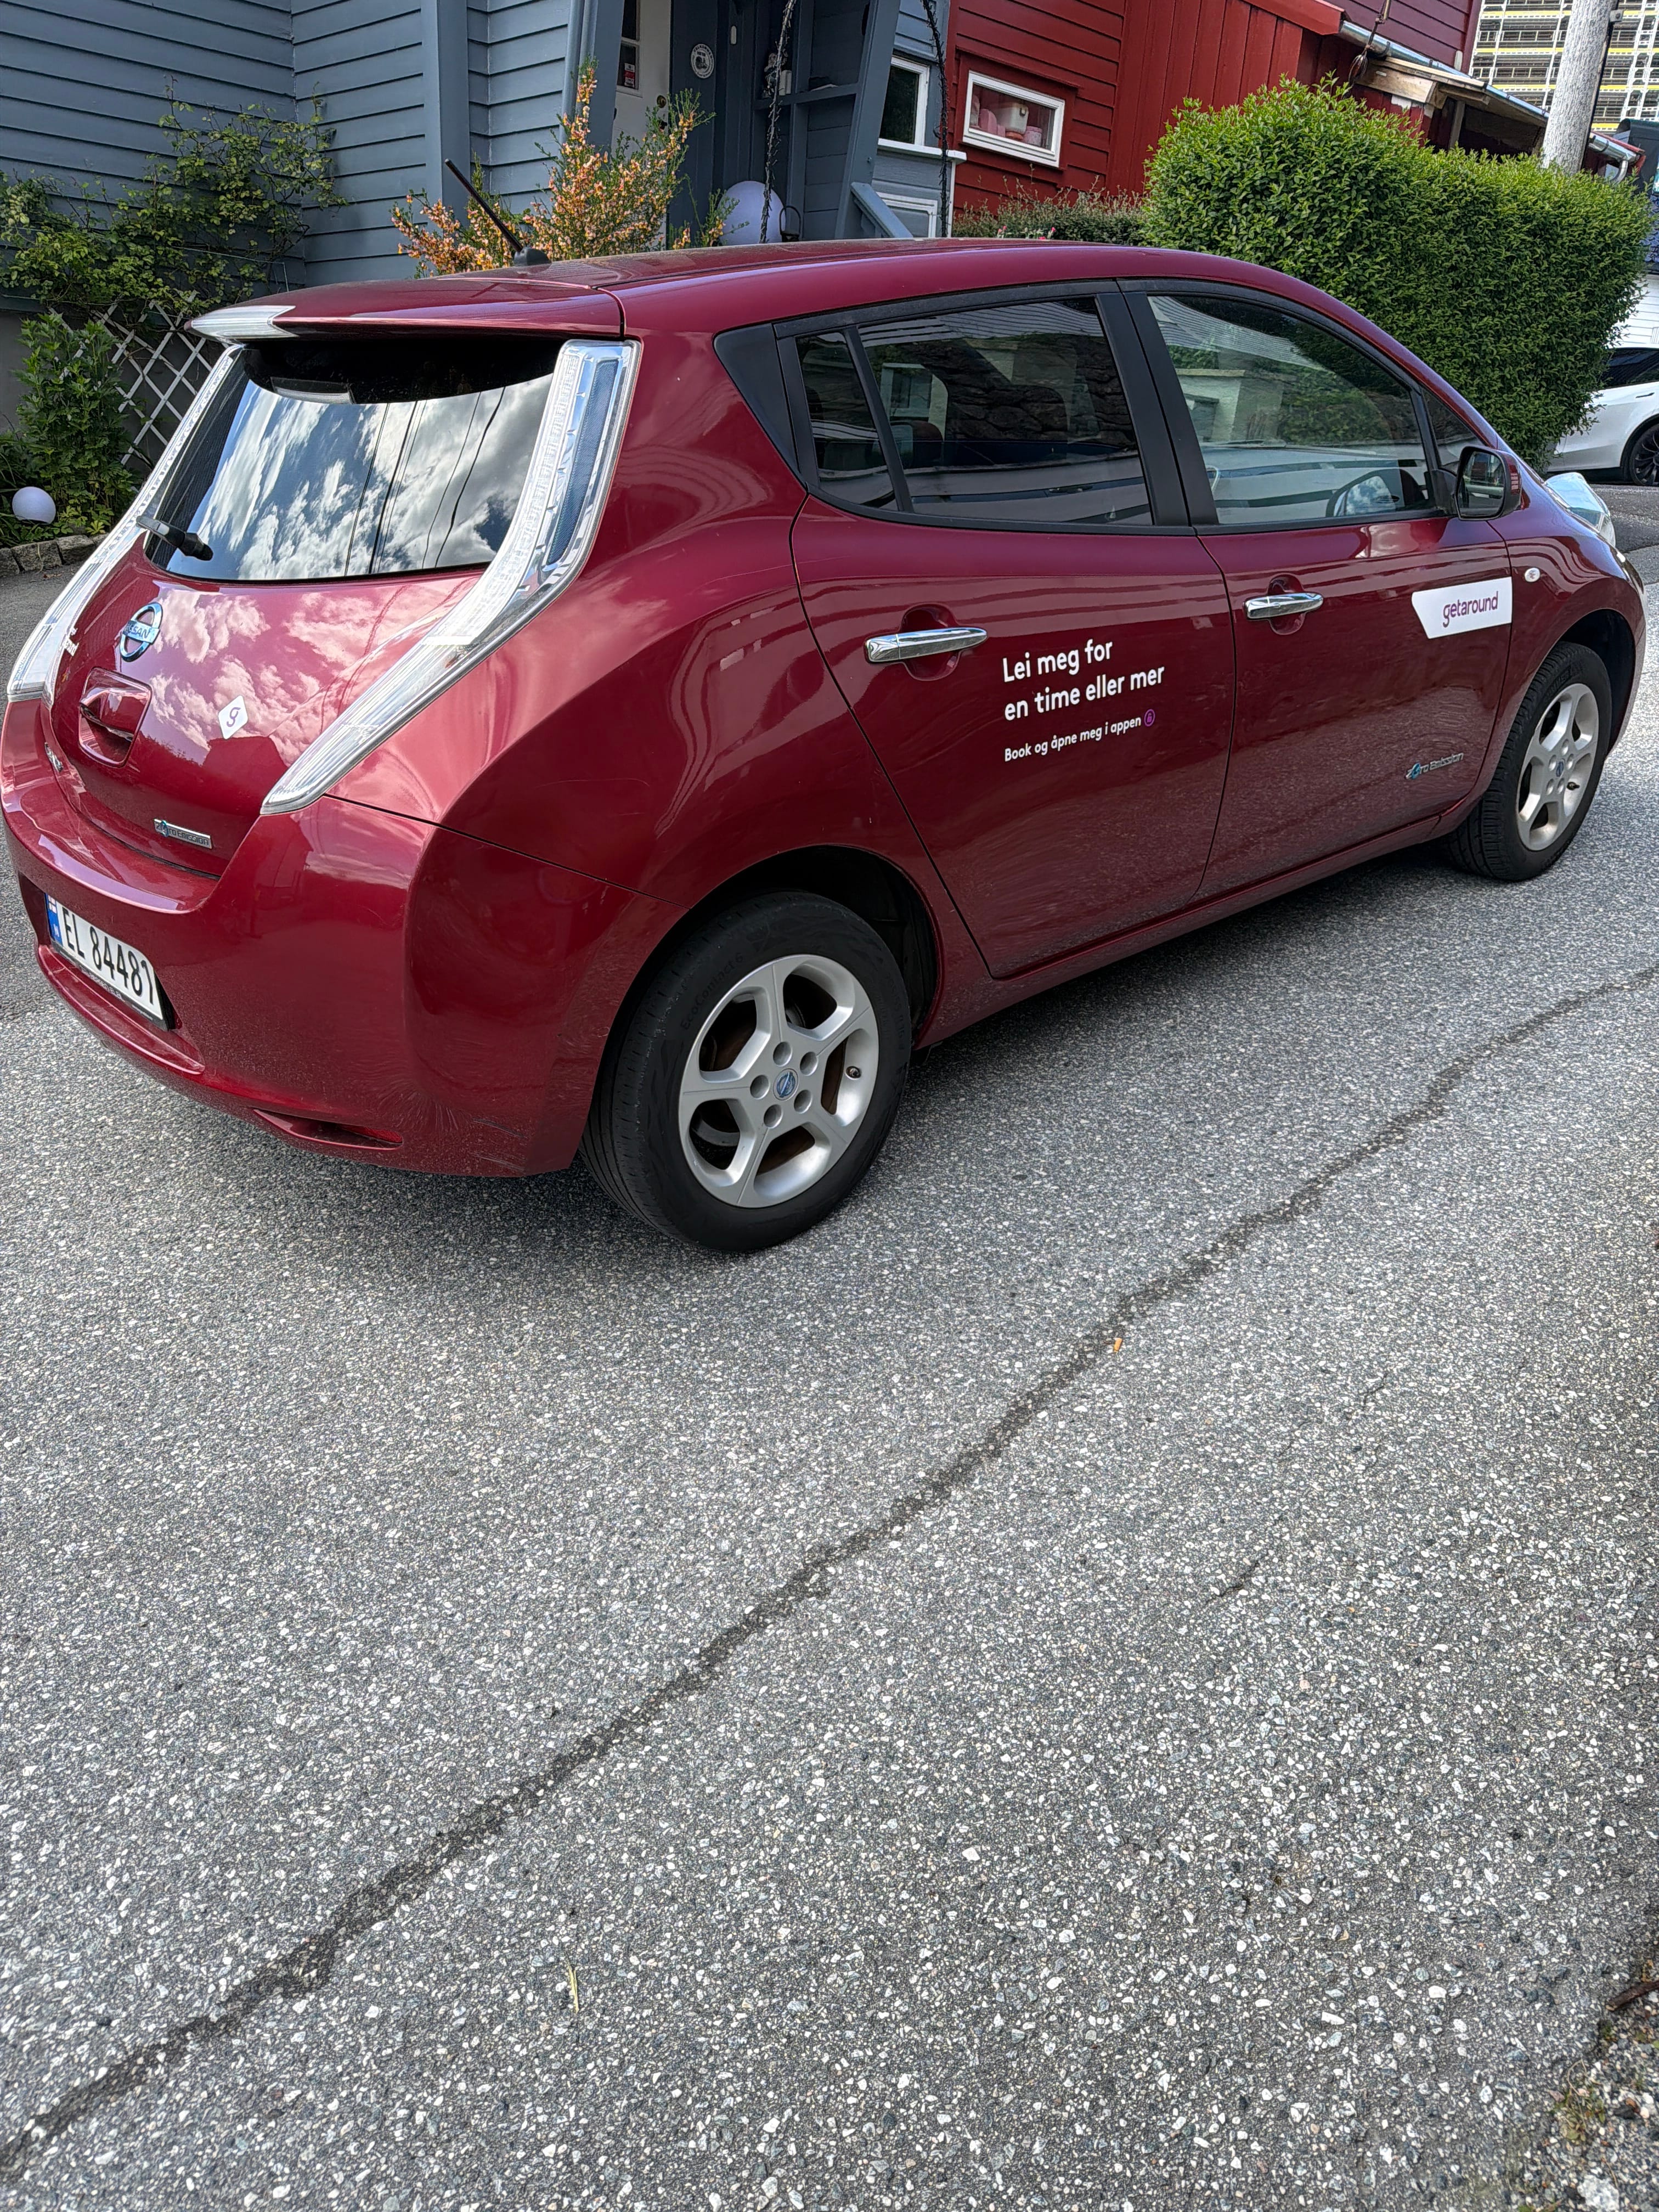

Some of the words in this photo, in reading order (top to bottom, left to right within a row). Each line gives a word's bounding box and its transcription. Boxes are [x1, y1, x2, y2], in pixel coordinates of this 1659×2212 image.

[1442, 591, 1498, 628] getaround
[1003, 652, 1031, 682] Lei
[1037, 649, 1080, 675] meg
[1084, 639, 1113, 664] for
[1005, 700, 1028, 721] en
[1034, 686, 1080, 713] time
[1086, 674, 1125, 701] eller
[1130, 667, 1165, 691] mer
[1005, 743, 1032, 762] Book
[1034, 740, 1048, 755] og
[1051, 735, 1077, 752] åpne
[1080, 727, 1102, 742] meg
[1105, 721, 1108, 735] i
[1110, 717, 1142, 736] appen
[62, 906, 85, 959] EL
[89, 926, 153, 1005] 84481
